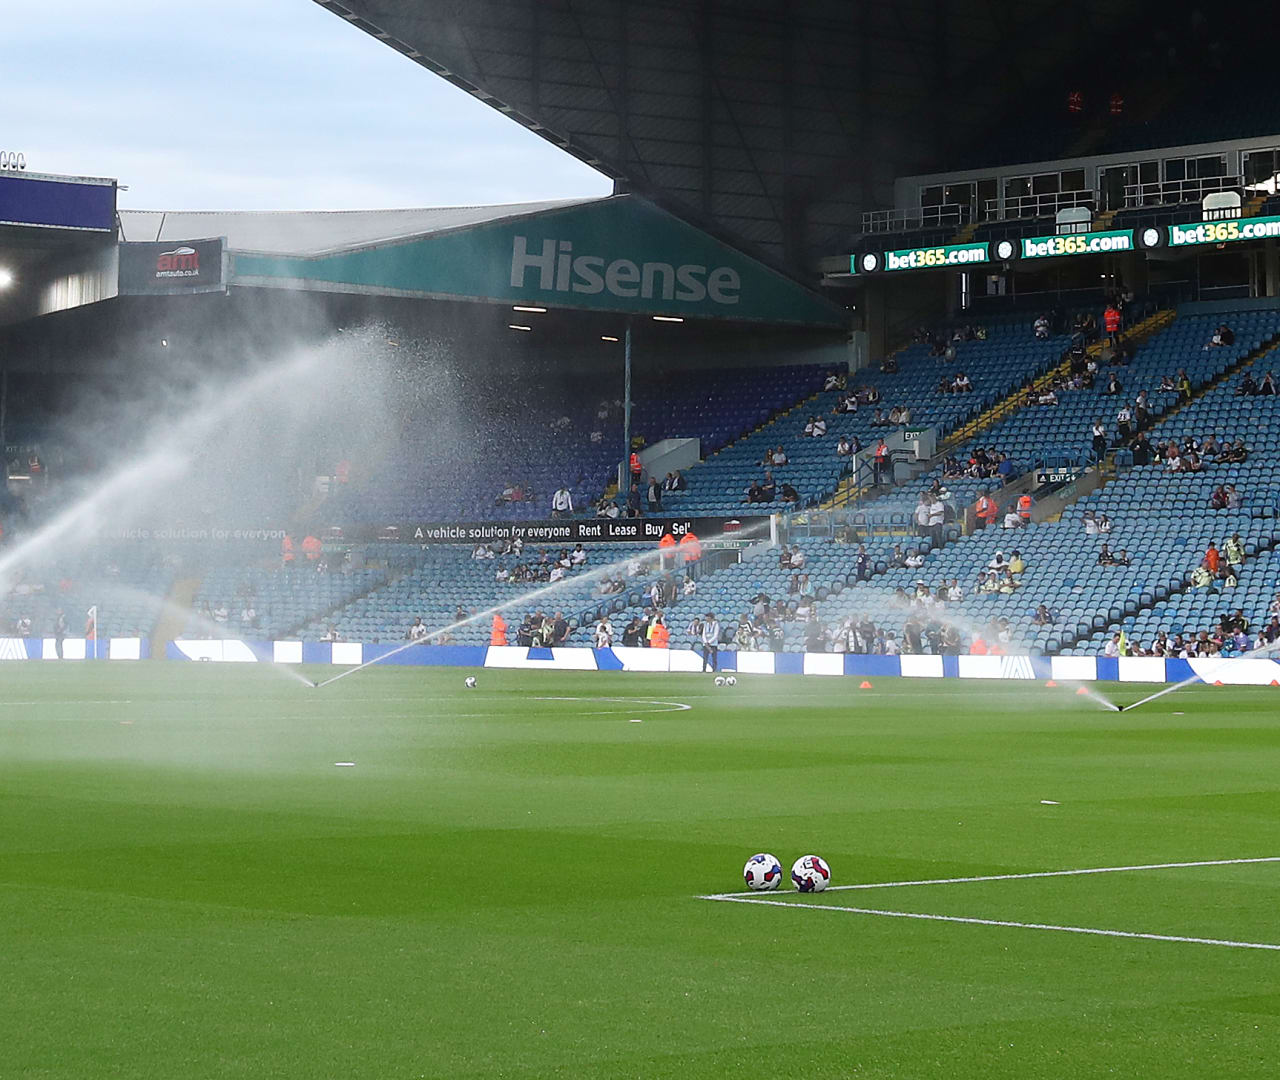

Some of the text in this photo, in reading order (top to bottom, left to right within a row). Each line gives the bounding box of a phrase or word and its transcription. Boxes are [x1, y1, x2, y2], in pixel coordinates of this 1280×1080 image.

[1025, 234, 1129, 257] bet365.com
[888, 247, 985, 270] bet365.com
[156, 269, 200, 278] amtauto.co.uk
[510, 235, 741, 304] Hisense
[1050, 474, 1065, 482] EXIT
[154, 527, 209, 539] solution
[233, 528, 286, 541] everyon
[414, 527, 424, 539] A
[426, 526, 466, 538] vehicle
[469, 525, 509, 538] solution
[511, 525, 526, 537] for
[527, 525, 570, 539] everyone
[578, 524, 601, 537] Rent
[609, 523, 637, 536] Lease
[645, 523, 664, 537] Buy
